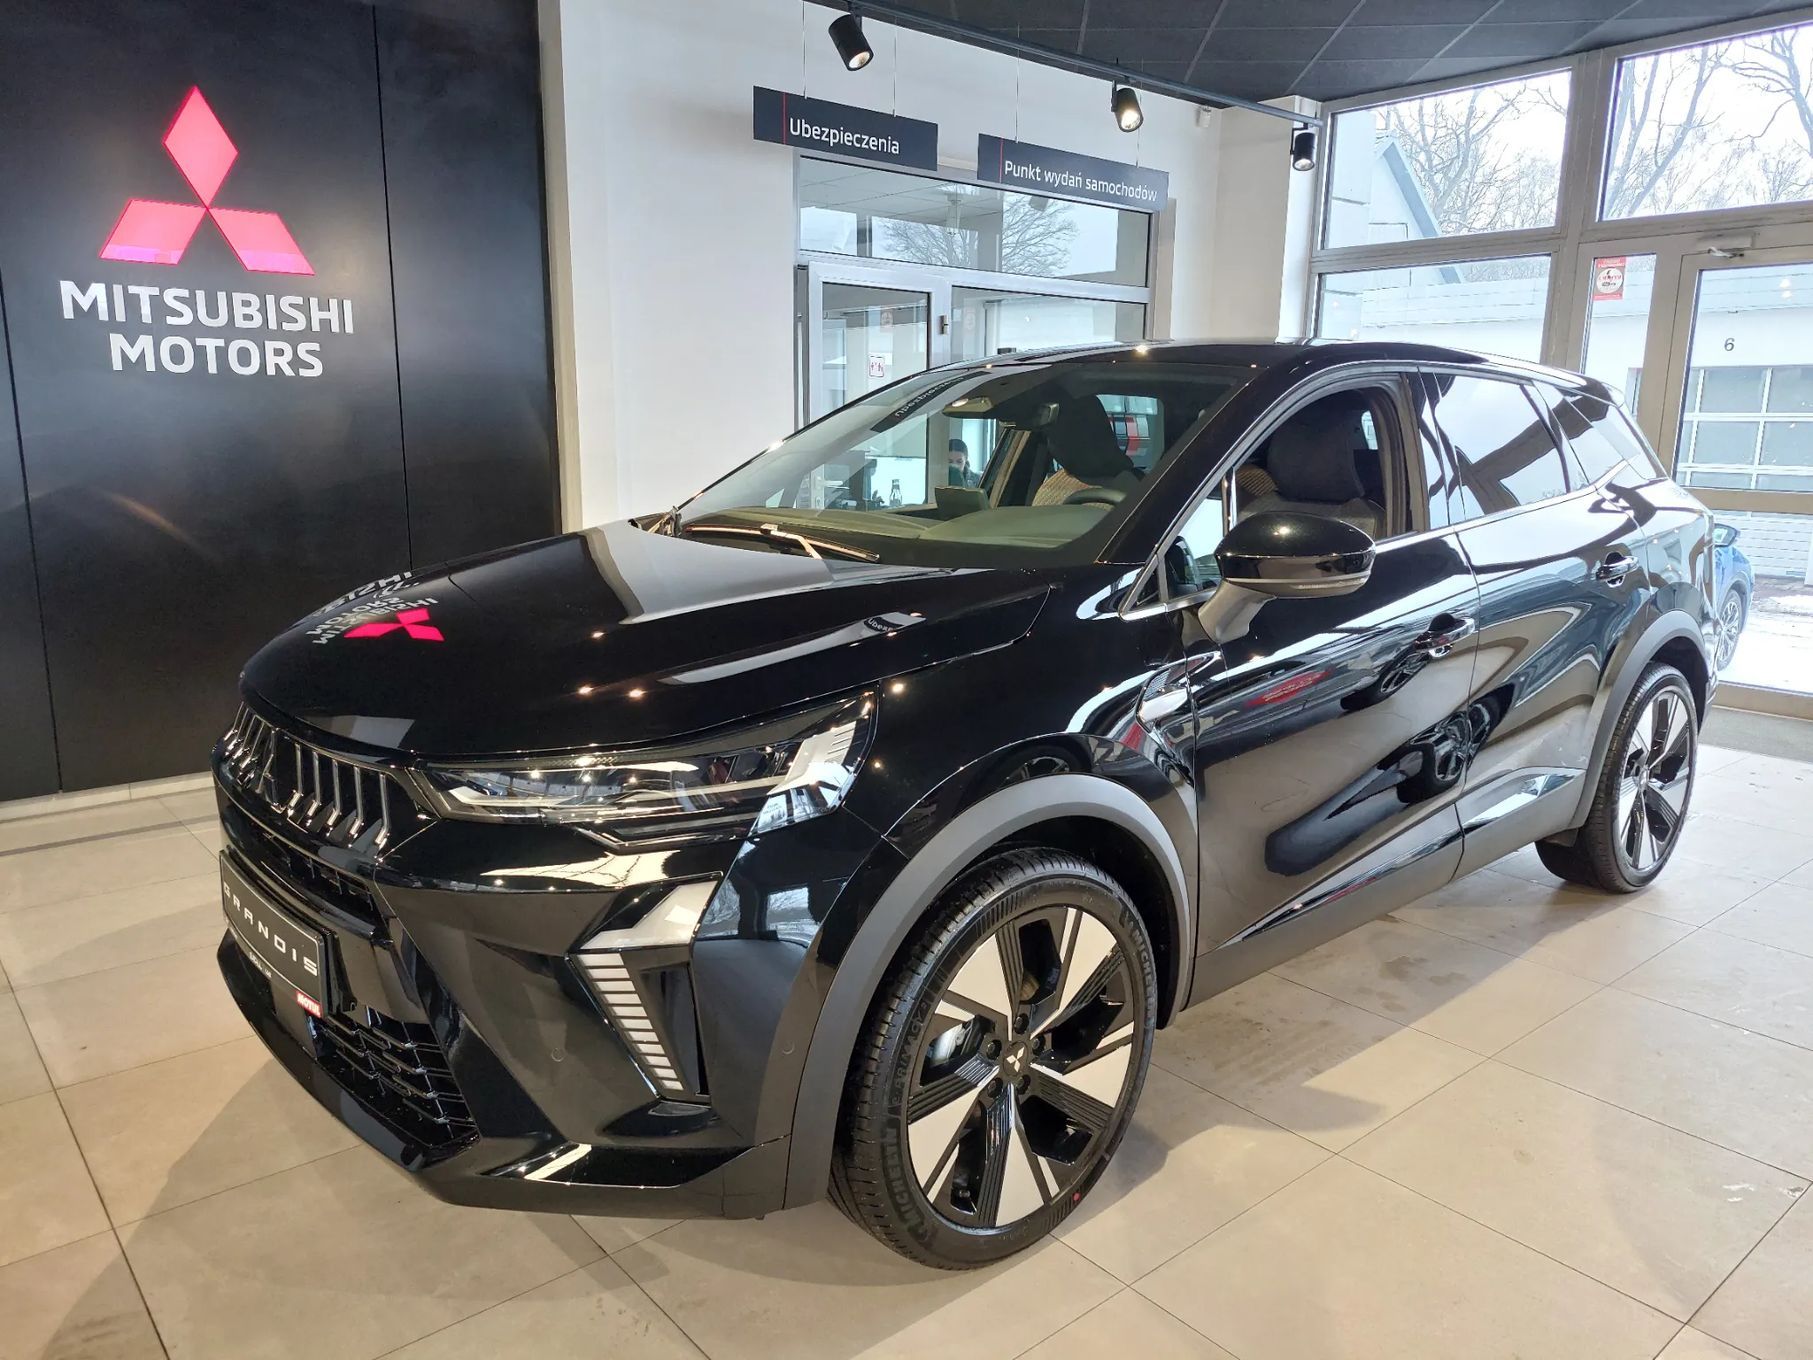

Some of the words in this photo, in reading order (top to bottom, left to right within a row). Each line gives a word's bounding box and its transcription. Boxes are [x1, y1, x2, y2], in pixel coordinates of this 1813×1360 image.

[789, 117, 900, 154] Ubezpieczenia
[1005, 160, 1042, 182] Punkt
[1044, 170, 1083, 188] wydań
[1085, 177, 1158, 202] samochodów
[60, 280, 354, 334] MITSUBISHI
[109, 333, 323, 377] MOTORS
[1724, 337, 1735, 352] 6
[223, 881, 318, 977] GRANDIS
